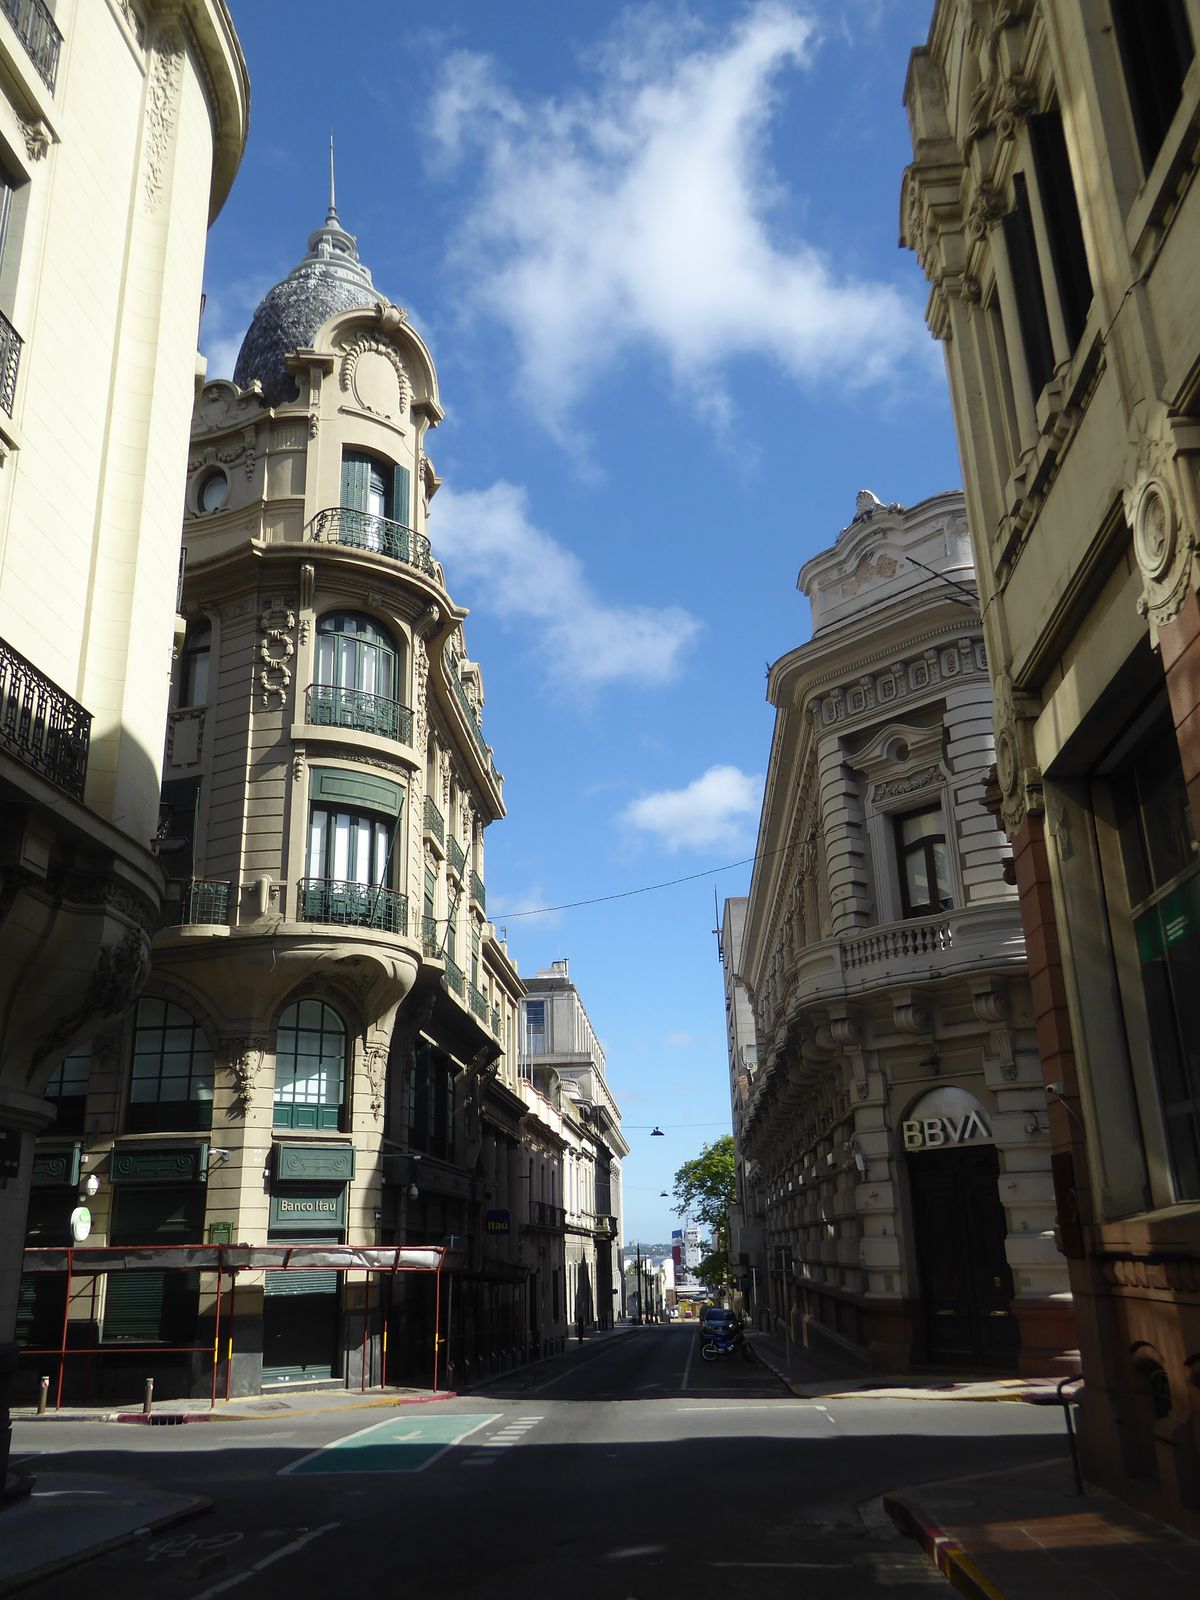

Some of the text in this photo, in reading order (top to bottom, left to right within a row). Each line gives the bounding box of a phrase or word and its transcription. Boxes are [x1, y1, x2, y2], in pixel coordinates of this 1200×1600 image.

[902, 1110, 989, 1148] BBVA
[281, 1199, 336, 1211] Banco Itaú
